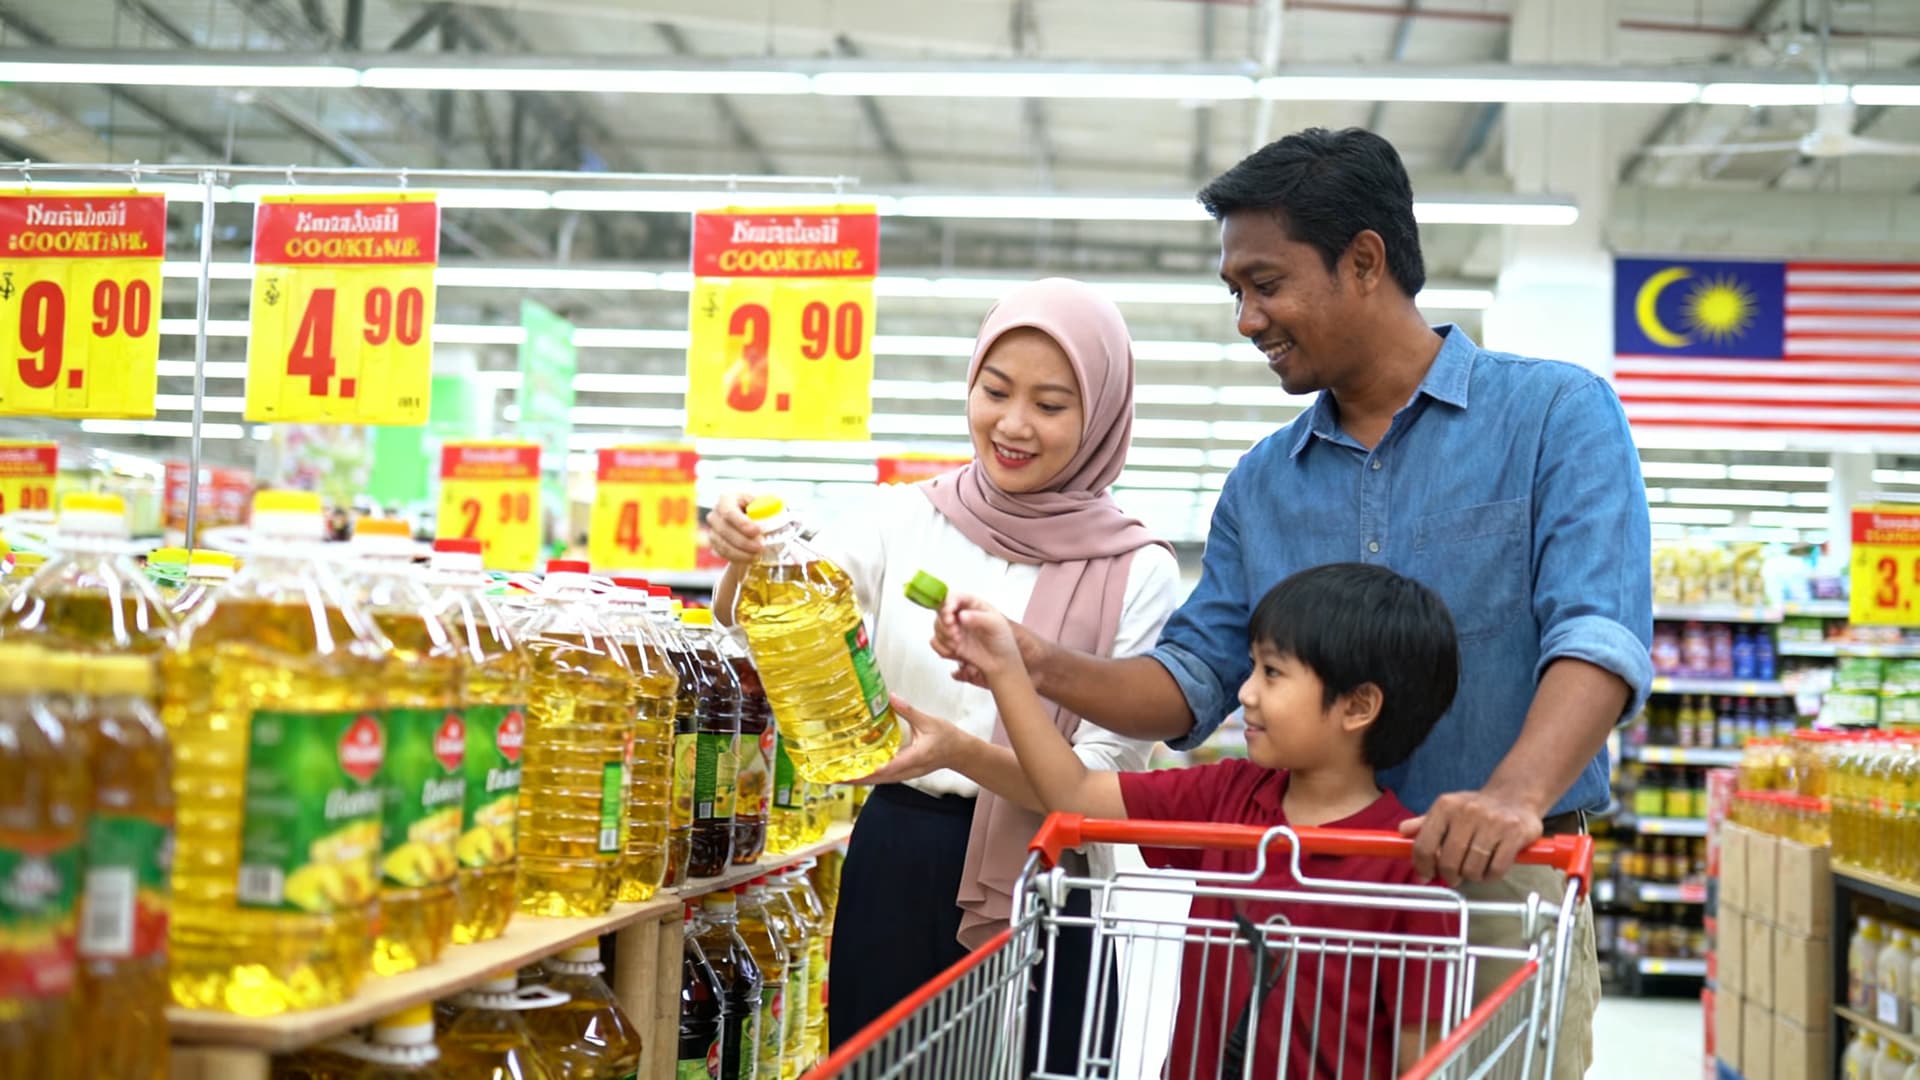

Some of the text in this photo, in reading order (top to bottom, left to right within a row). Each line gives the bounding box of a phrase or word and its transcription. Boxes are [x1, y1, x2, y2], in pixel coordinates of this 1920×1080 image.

[17, 279, 151, 389] 9. 90
[287, 287, 424, 398] 4. 90
[726, 301, 863, 412] 3. 90
